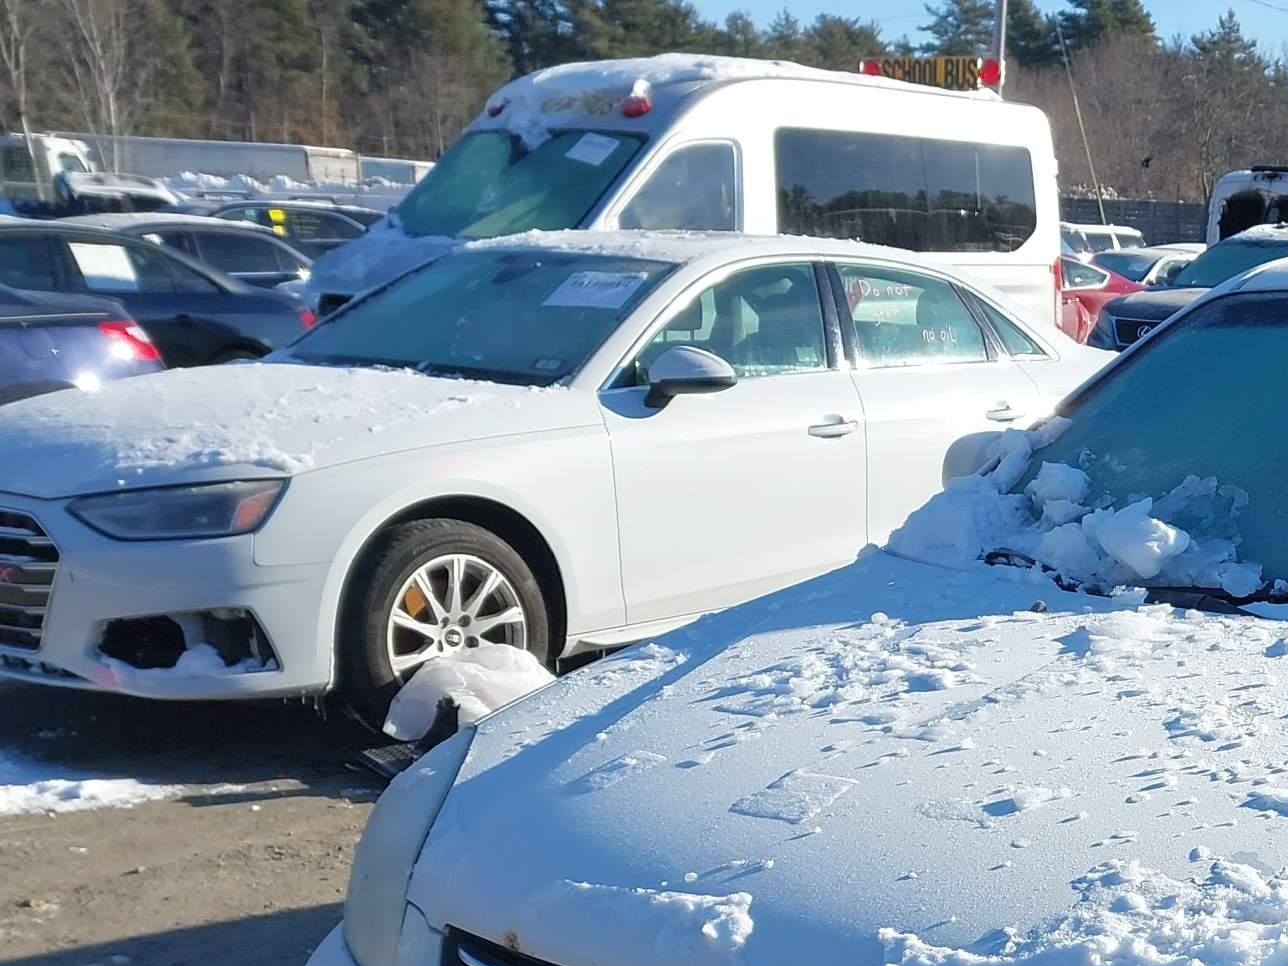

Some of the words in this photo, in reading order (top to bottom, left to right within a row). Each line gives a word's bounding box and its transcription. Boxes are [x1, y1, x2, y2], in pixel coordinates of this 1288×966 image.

[881, 58, 942, 85] SCHOOL
[945, 58, 978, 89] BUS
[859, 280, 880, 296] Do
[887, 285, 912, 296] not
[923, 328, 935, 342] no
[940, 321, 956, 341] oil
